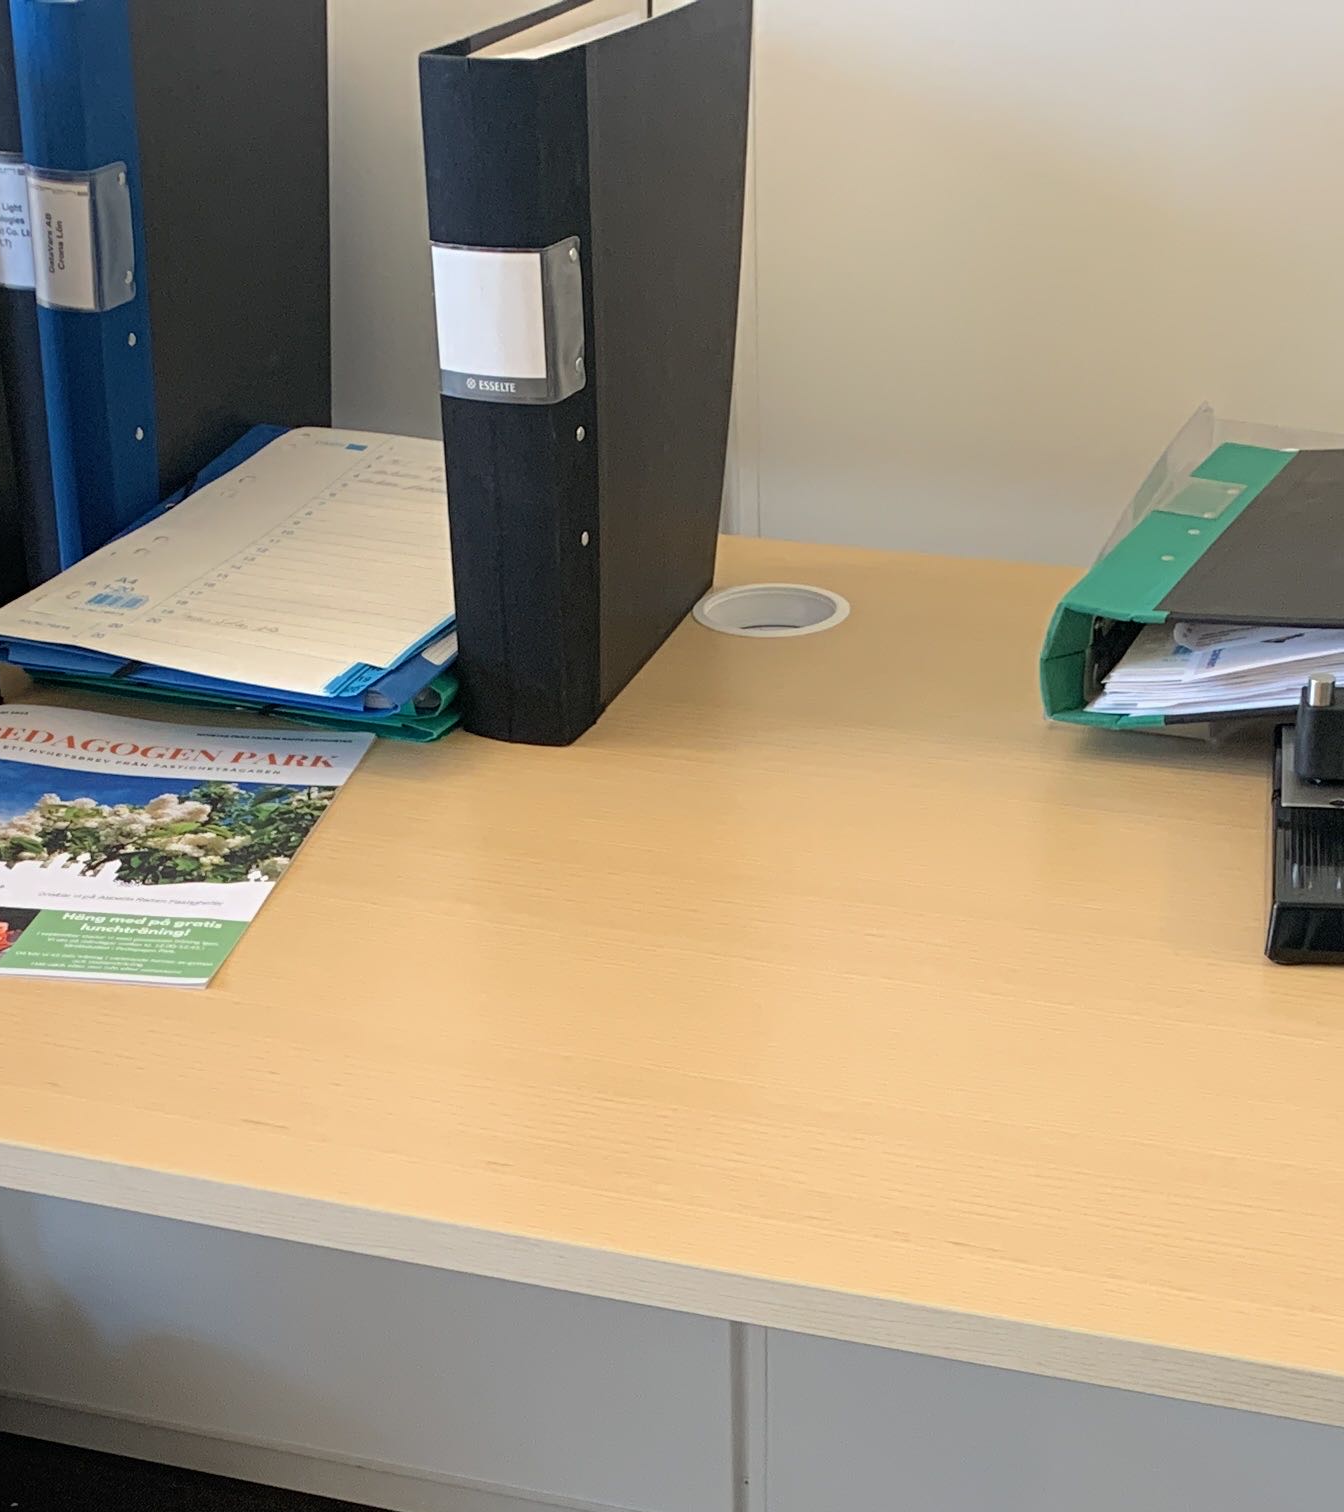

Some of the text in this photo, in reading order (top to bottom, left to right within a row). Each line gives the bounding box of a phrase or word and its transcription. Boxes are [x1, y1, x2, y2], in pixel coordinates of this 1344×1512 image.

[479, 380, 516, 393] ESSELTE
[29, 748, 110, 763] NYHETSBREV
[115, 760, 148, 768] FRÅN
[230, 751, 339, 768] PARK
[62, 912, 223, 930] Häng med på gratis
[80, 923, 191, 938] lunchträning!
